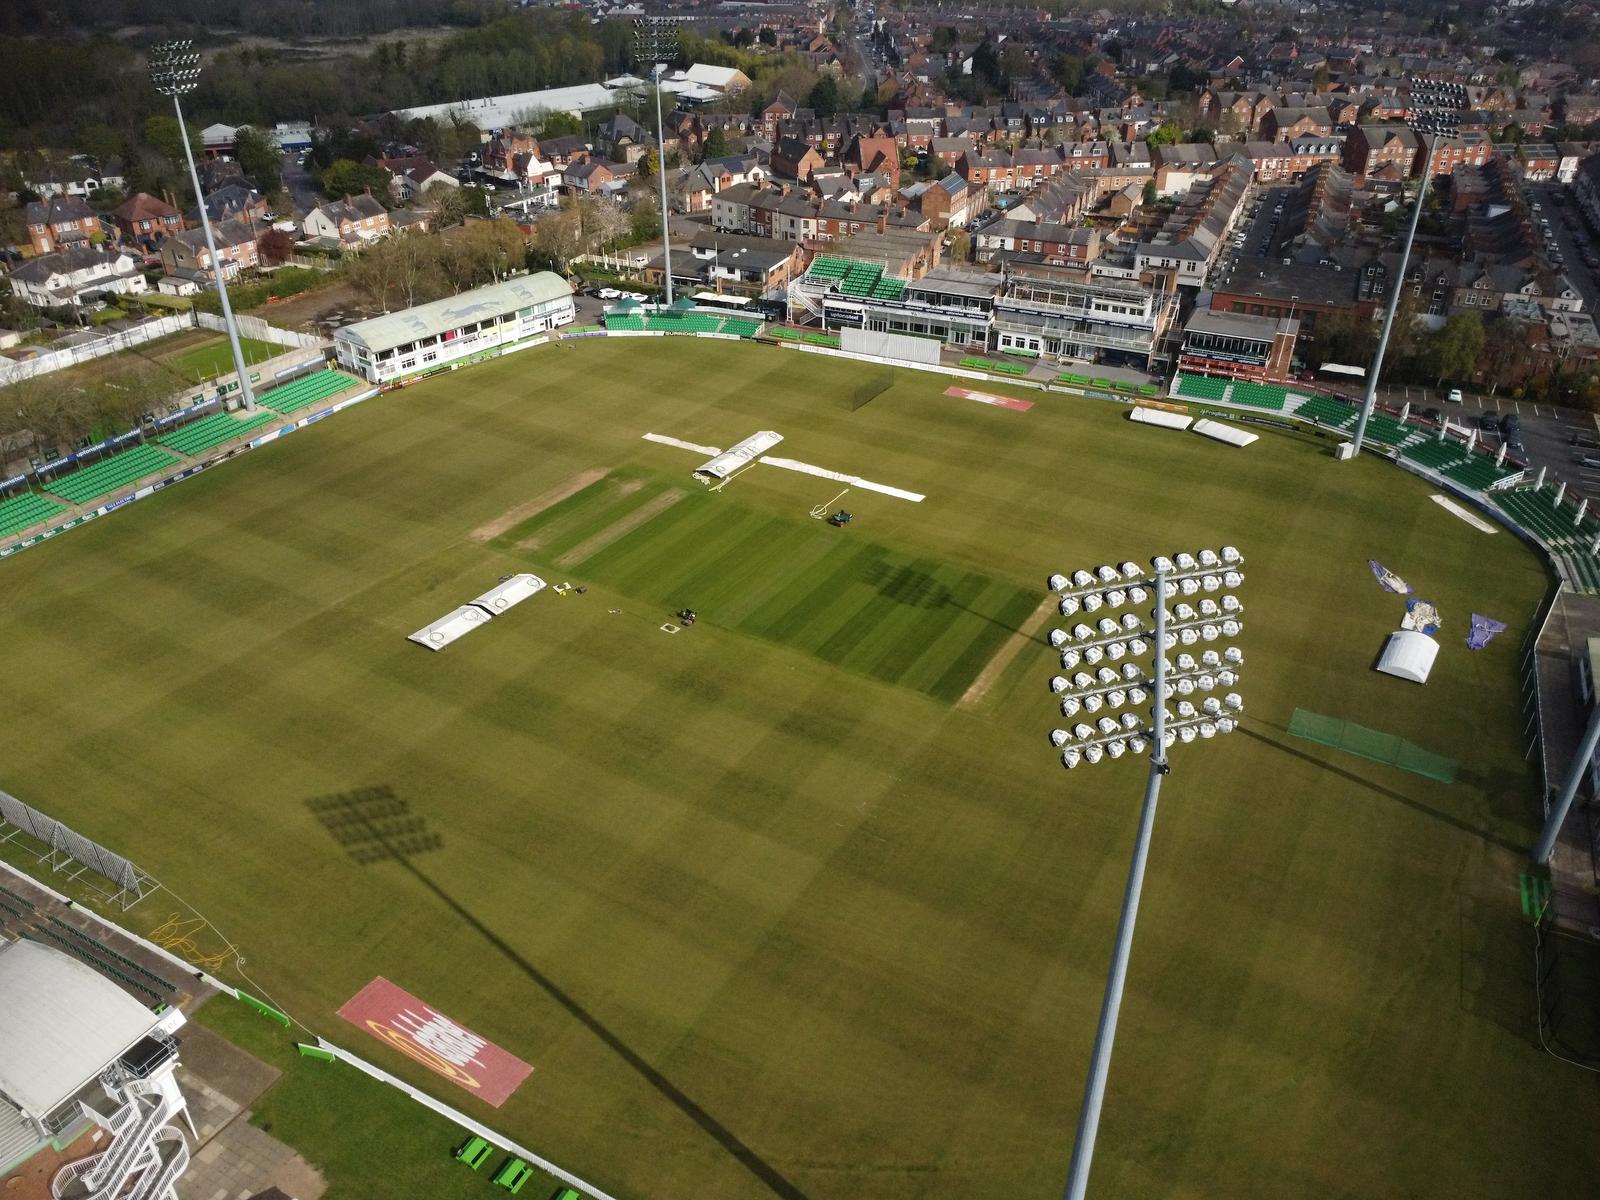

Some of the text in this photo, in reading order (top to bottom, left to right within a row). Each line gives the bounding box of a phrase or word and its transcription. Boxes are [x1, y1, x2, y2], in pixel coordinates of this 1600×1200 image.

[830, 312, 859, 321] uptonsteel
[76, 442, 106, 458] uptonsteel
[37, 457, 69, 473] uptonsteel
